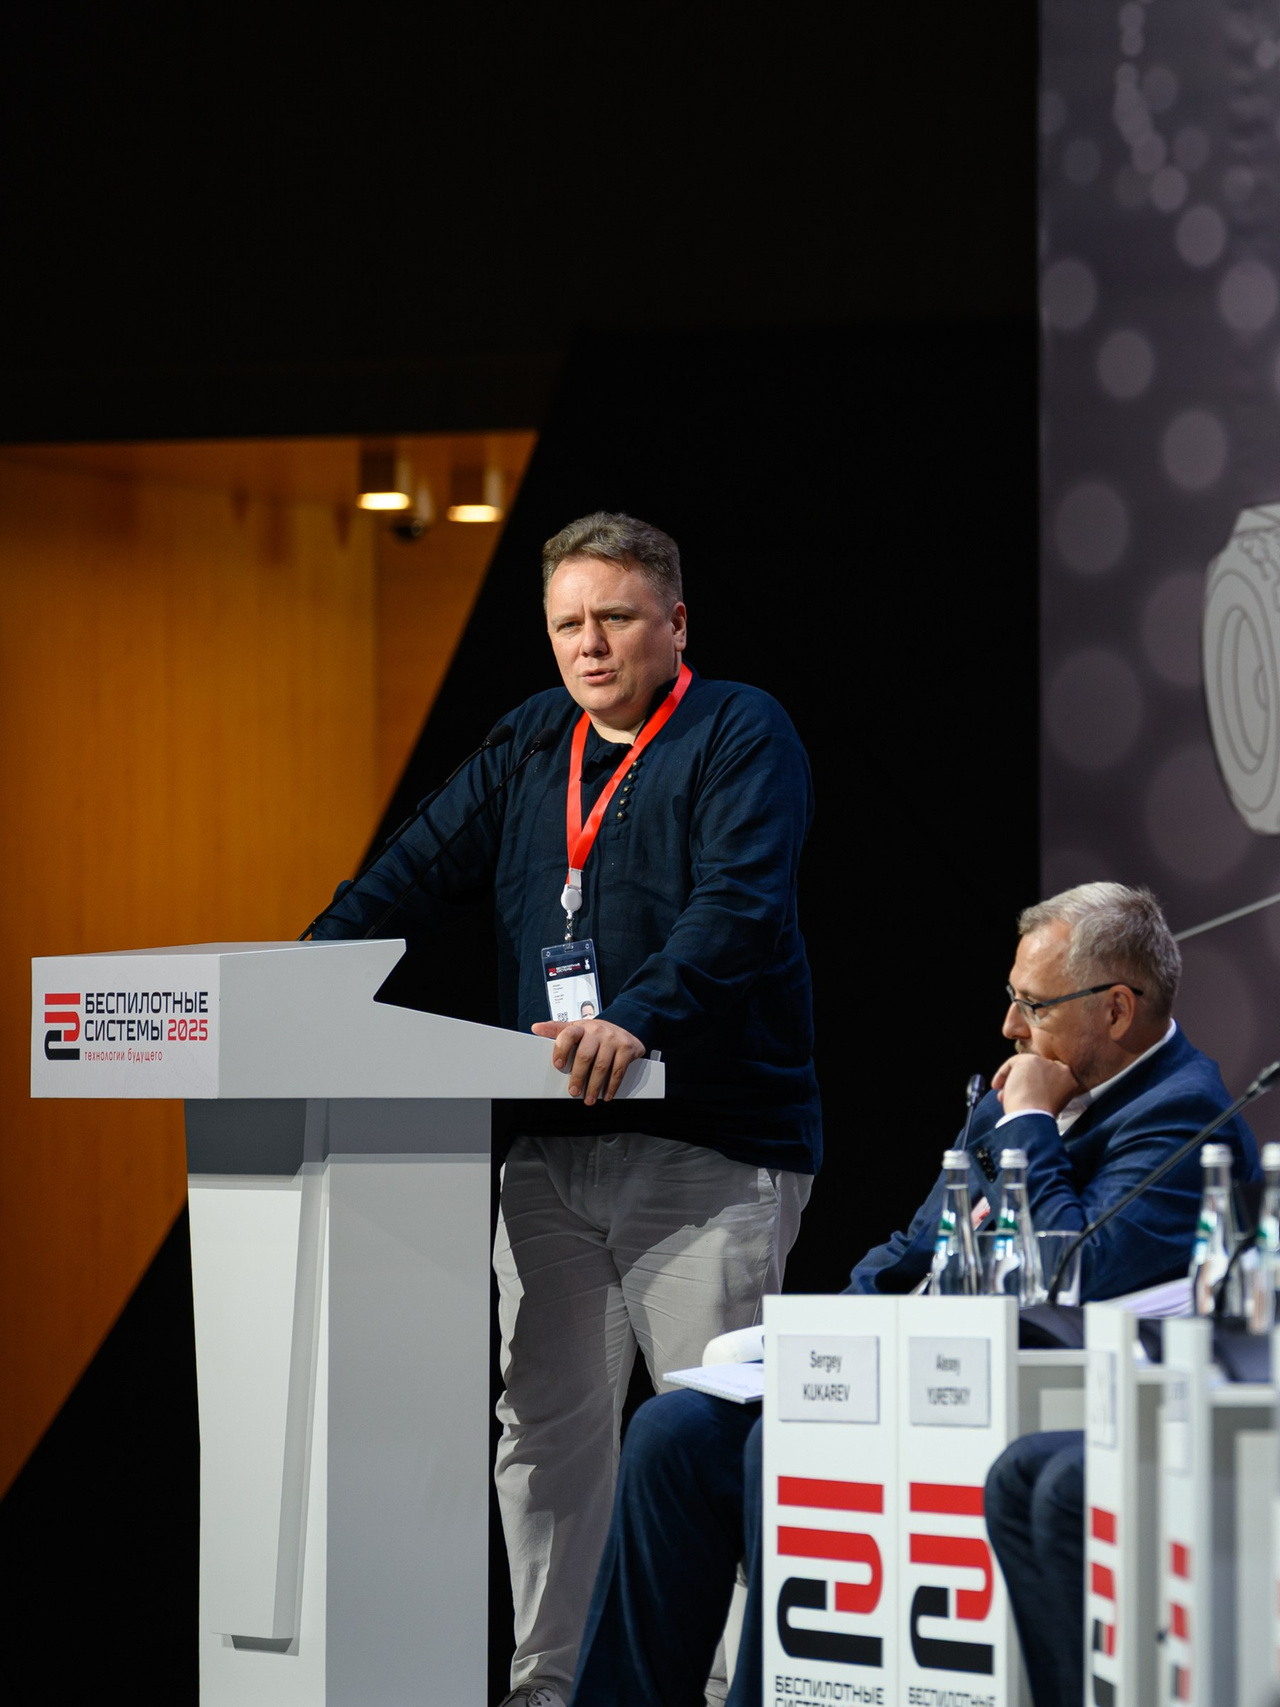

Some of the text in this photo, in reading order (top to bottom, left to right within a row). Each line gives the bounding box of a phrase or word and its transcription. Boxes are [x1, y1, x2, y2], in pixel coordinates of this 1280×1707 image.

[85, 991, 209, 1014] БЕСПИЛОТНЫЕ
[84, 1019, 209, 1041] СИСТЕМЫ 2025
[84, 1048, 163, 1063] технологии будущего
[809, 1350, 843, 1374] Sergey
[803, 1383, 851, 1402] KUKAREV
[775, 1675, 885, 1706] БЕСПИЛОТНЫЕ
